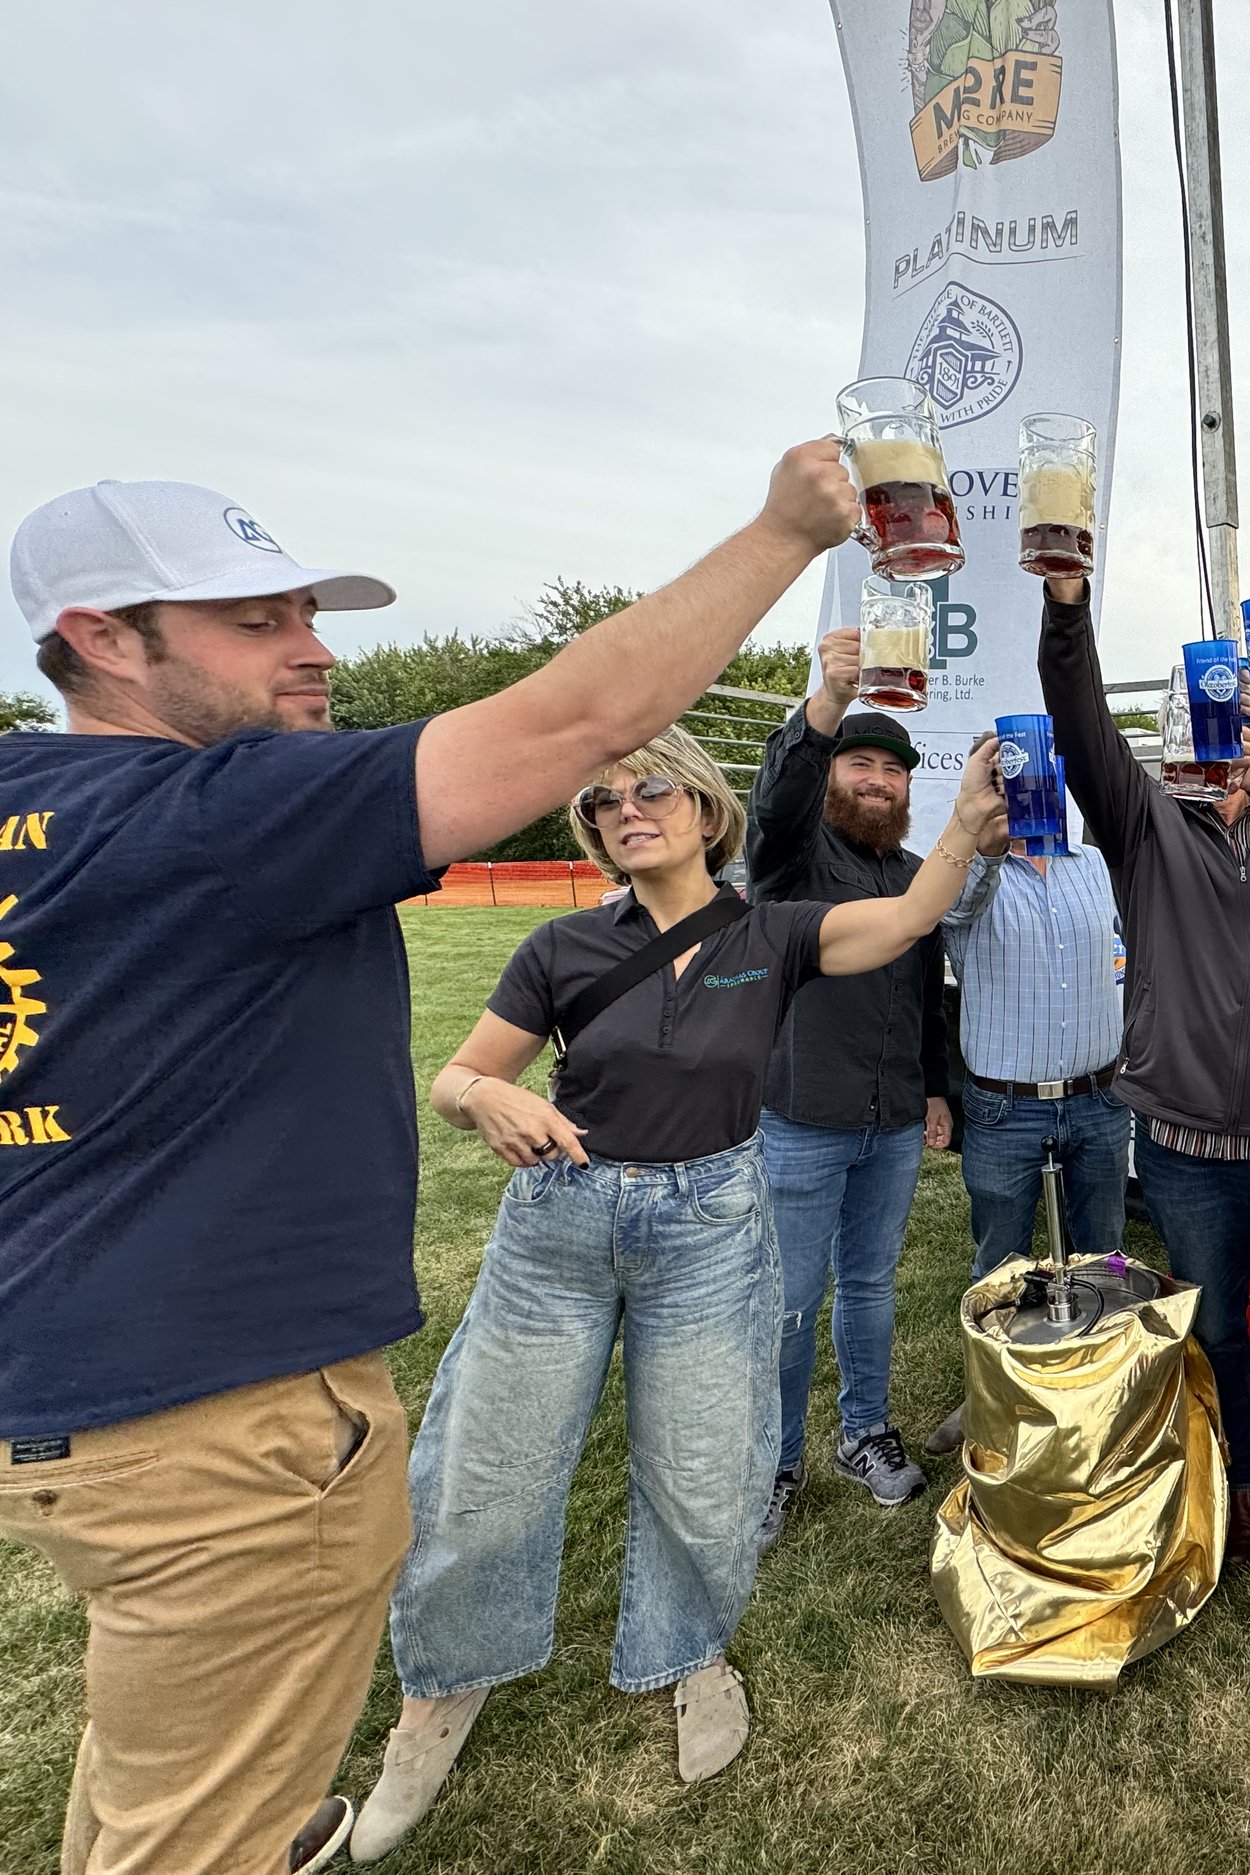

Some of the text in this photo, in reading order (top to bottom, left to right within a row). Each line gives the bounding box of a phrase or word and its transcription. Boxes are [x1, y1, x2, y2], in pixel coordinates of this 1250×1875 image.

[978, 304, 1014, 353] BARTLETT
[938, 362, 960, 390] 1891
[940, 378, 1009, 423] WITH PRIDE
[955, 674, 985, 686] Burke
[955, 688, 974, 700] Ltd.
[0, 1105, 72, 1146] RK
